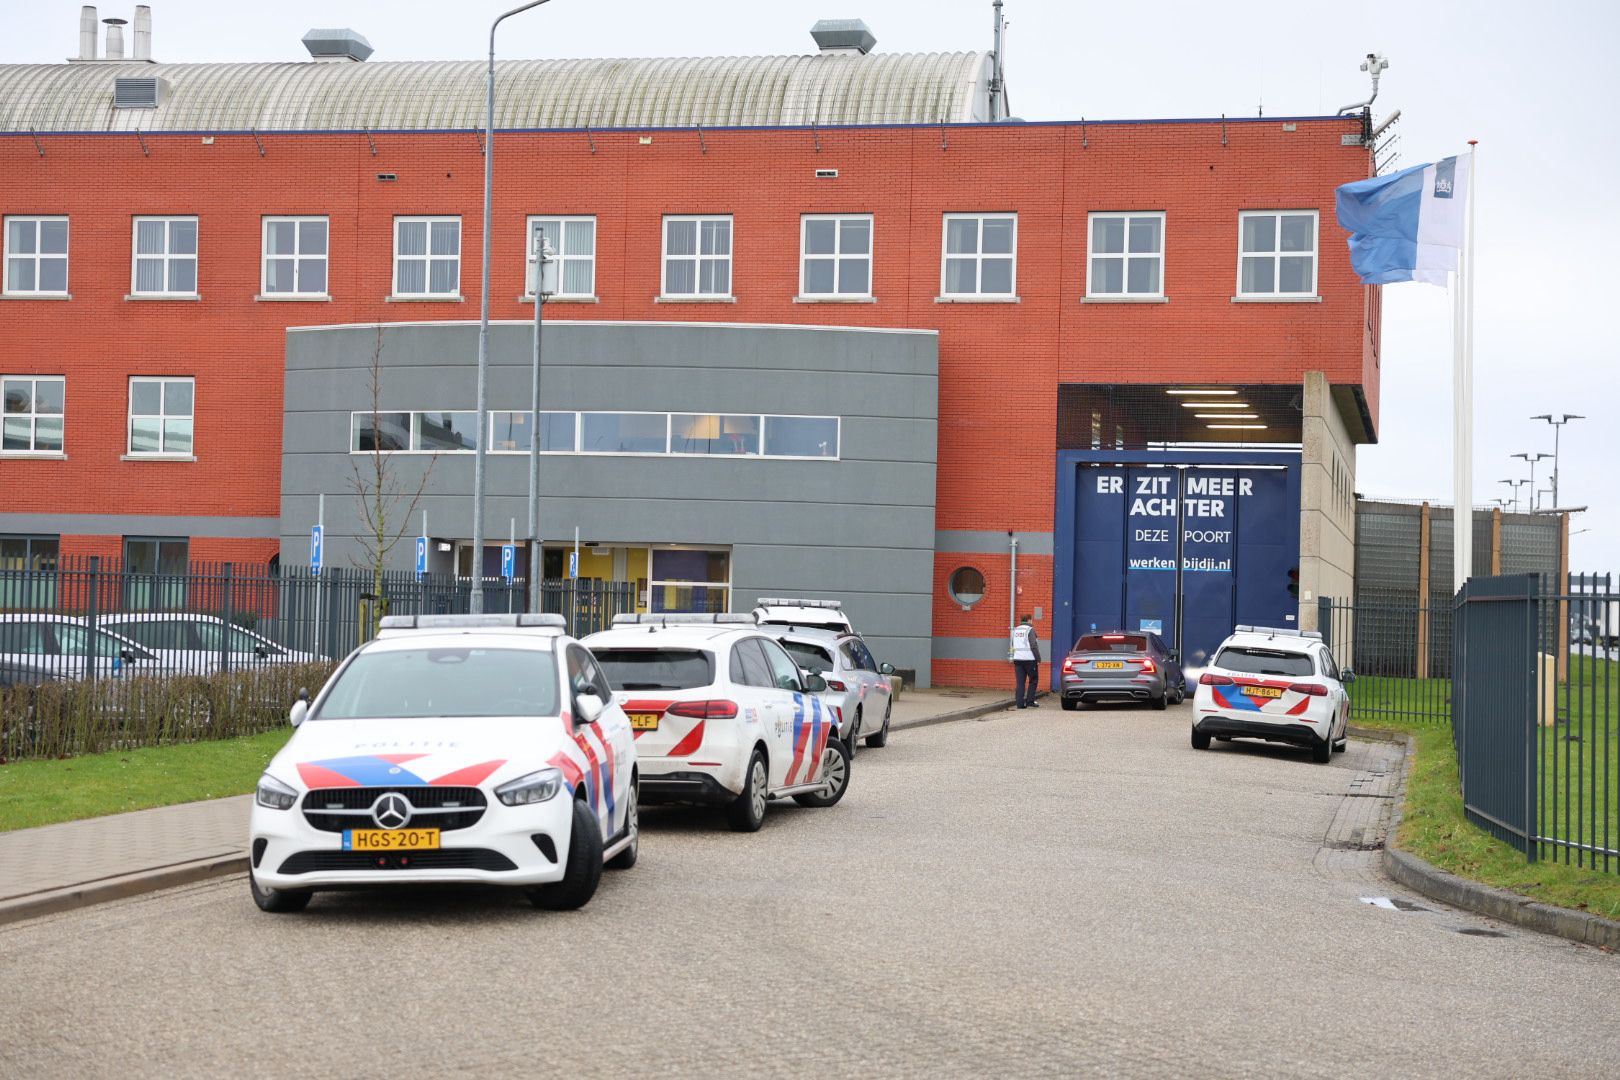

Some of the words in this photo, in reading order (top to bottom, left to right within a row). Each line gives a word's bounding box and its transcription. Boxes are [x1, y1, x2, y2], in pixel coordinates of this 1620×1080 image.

[1097, 476, 1123, 494] ER
[1136, 477, 1170, 495] ZIT
[1188, 478, 1253, 496] MEER
[313, 531, 319, 557] P
[1135, 529, 1169, 542] DEZE
[1184, 530, 1231, 543] POORT
[418, 543, 424, 565] P
[504, 549, 511, 568] P
[357, 831, 436, 847] HGS-20-T
